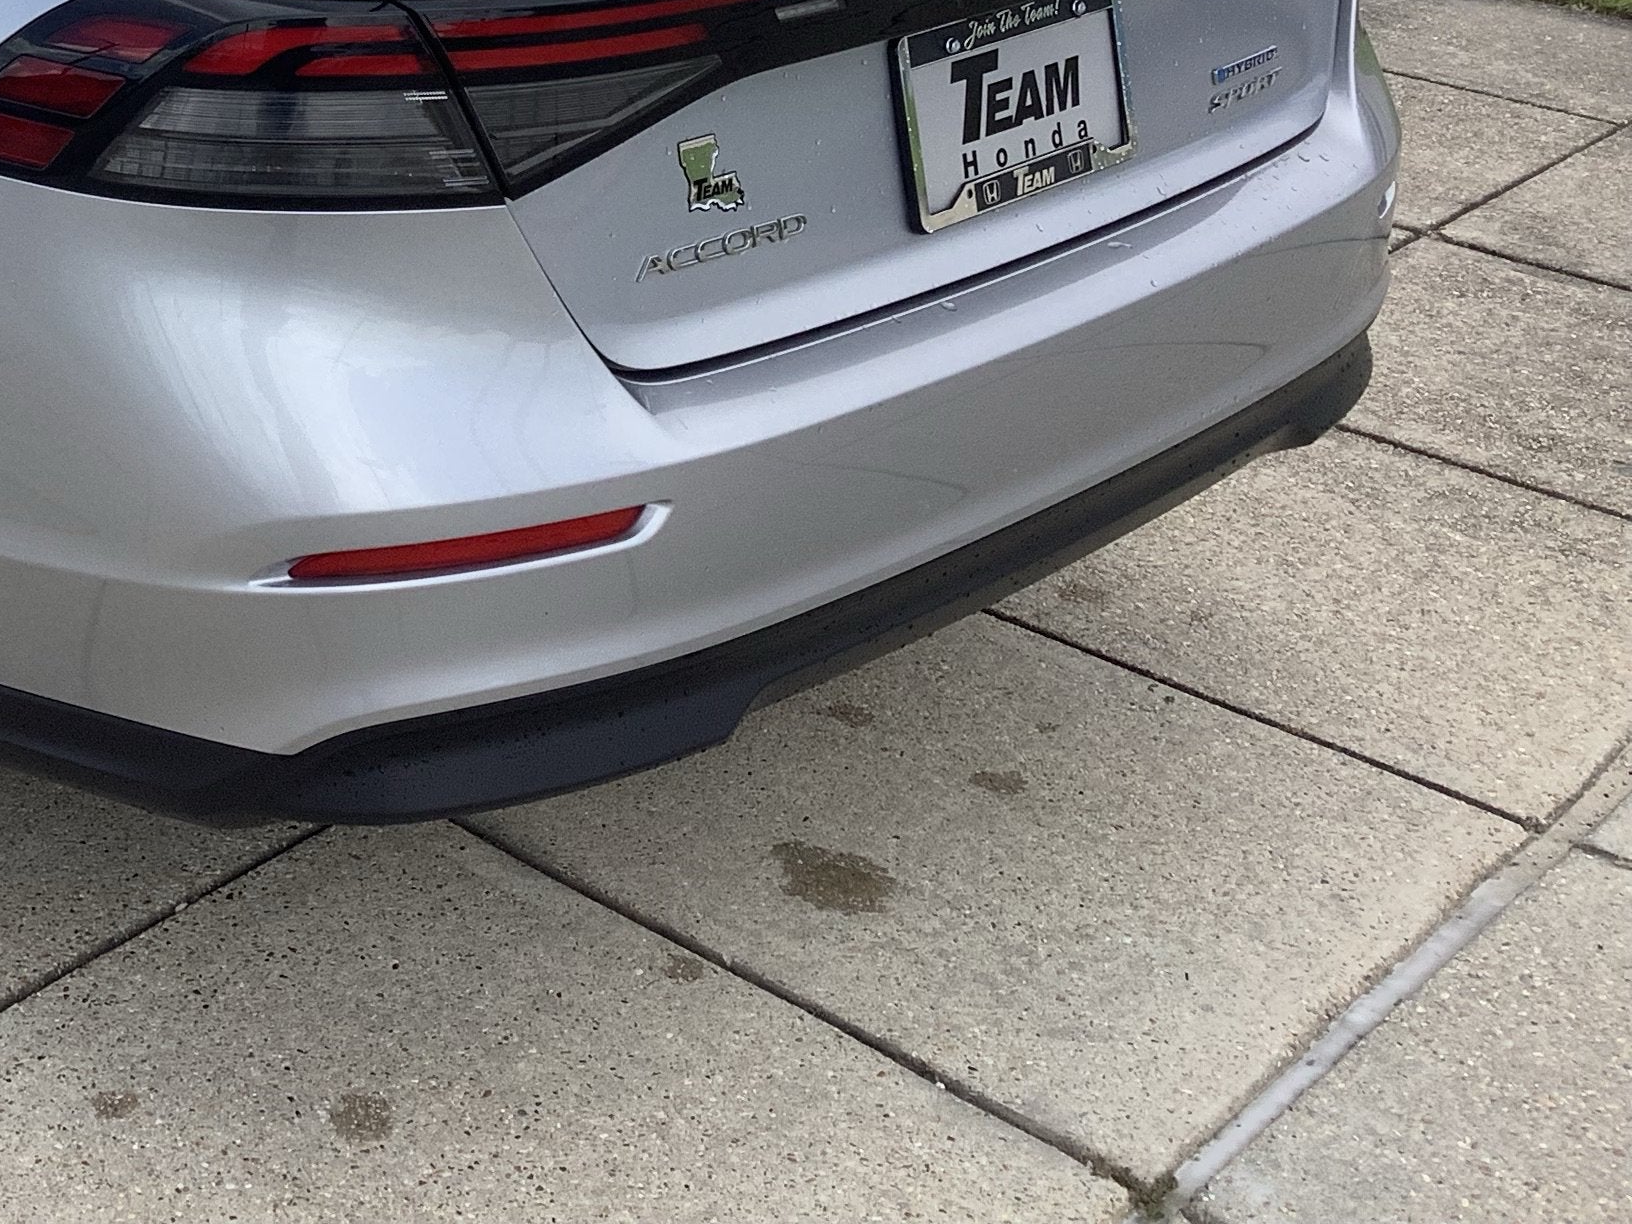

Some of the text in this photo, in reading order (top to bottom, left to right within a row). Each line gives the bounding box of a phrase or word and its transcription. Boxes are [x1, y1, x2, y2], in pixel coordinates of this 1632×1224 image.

[964, 20, 996, 50] Join
[995, 8, 1021, 33] The
[1223, 47, 1277, 81] HYBRID
[950, 48, 1080, 145] TEAM
[1208, 66, 1282, 114] SPORT
[962, 119, 1089, 179] Honda
[693, 177, 733, 201] TEAM
[1013, 166, 1055, 196] TEAM
[635, 213, 807, 282] ACCORD
